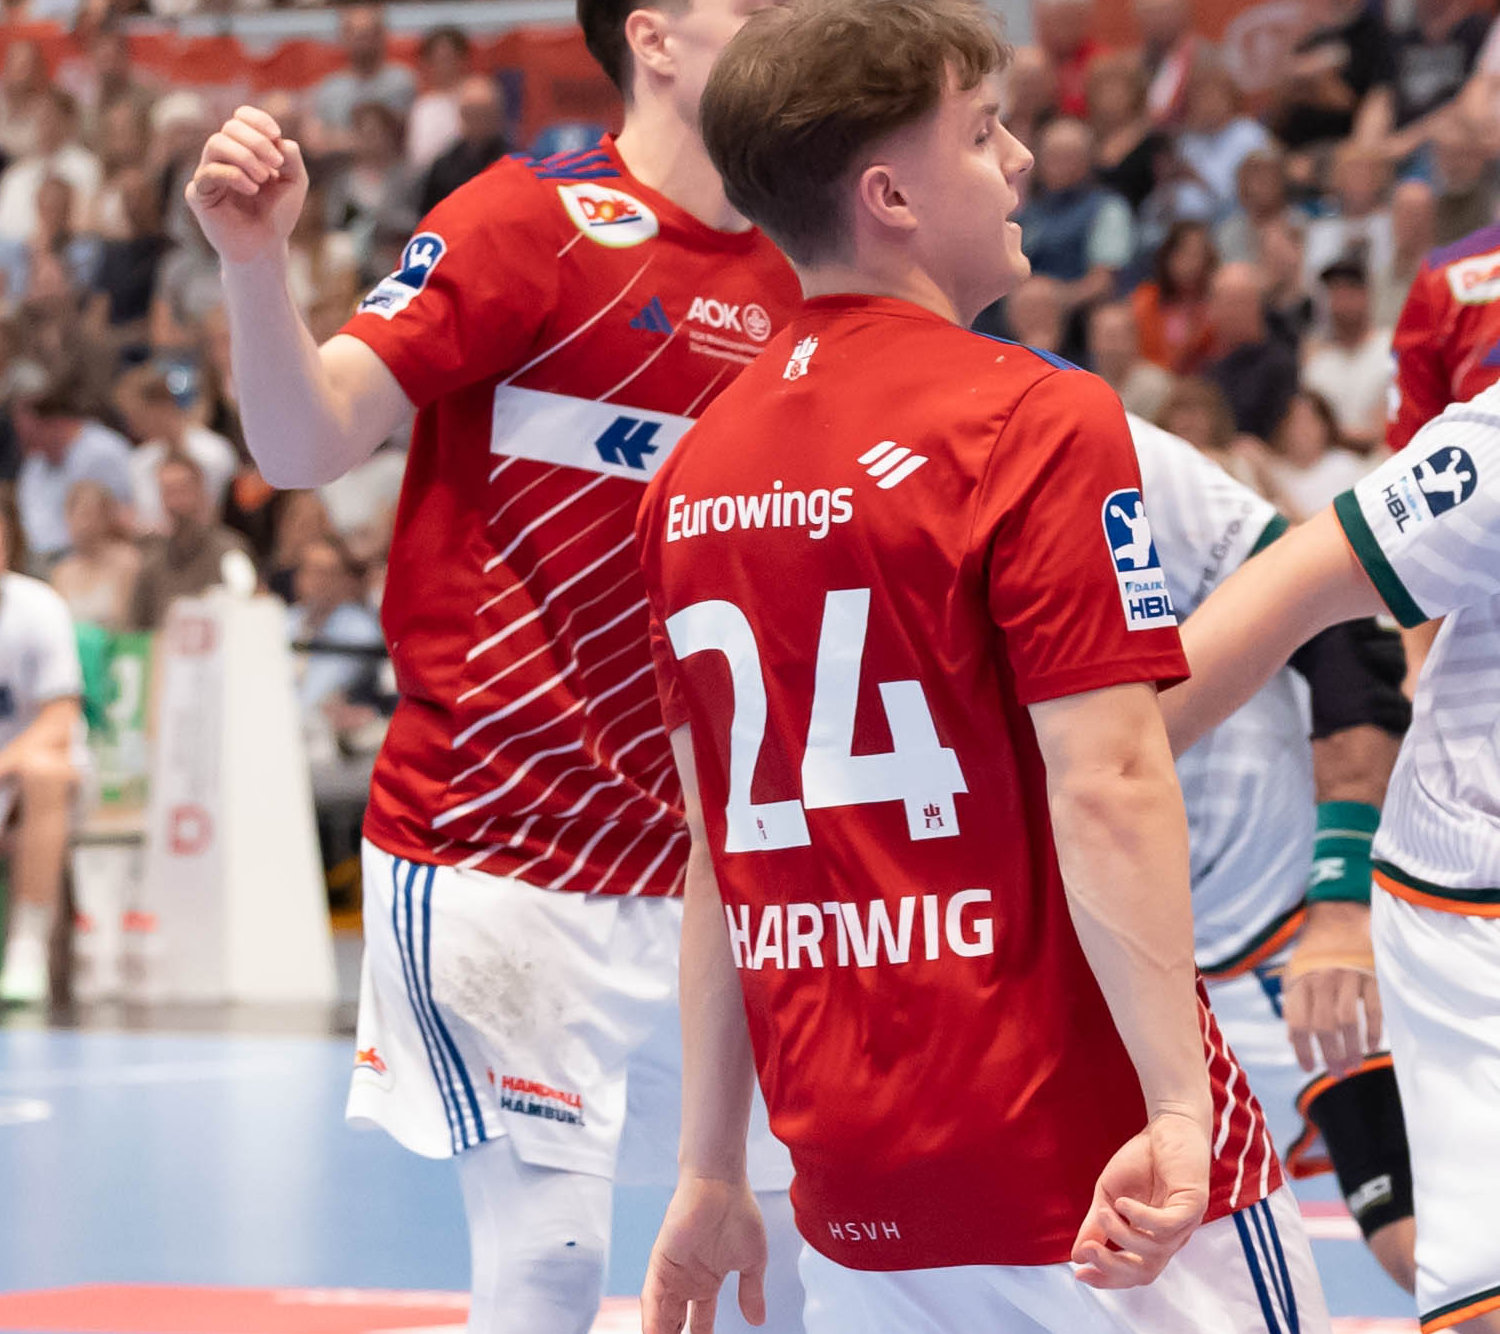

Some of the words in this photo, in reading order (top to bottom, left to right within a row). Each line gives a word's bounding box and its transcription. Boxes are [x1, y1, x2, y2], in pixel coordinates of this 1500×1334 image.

[687, 296, 742, 332] AOK
[666, 479, 854, 543] Eurowings
[1382, 483, 1410, 534] HBL
[1128, 595, 1177, 621] HBL
[665, 588, 970, 853] 24
[724, 888, 994, 970] HARTWIG
[827, 1221, 901, 1241] HSVH
